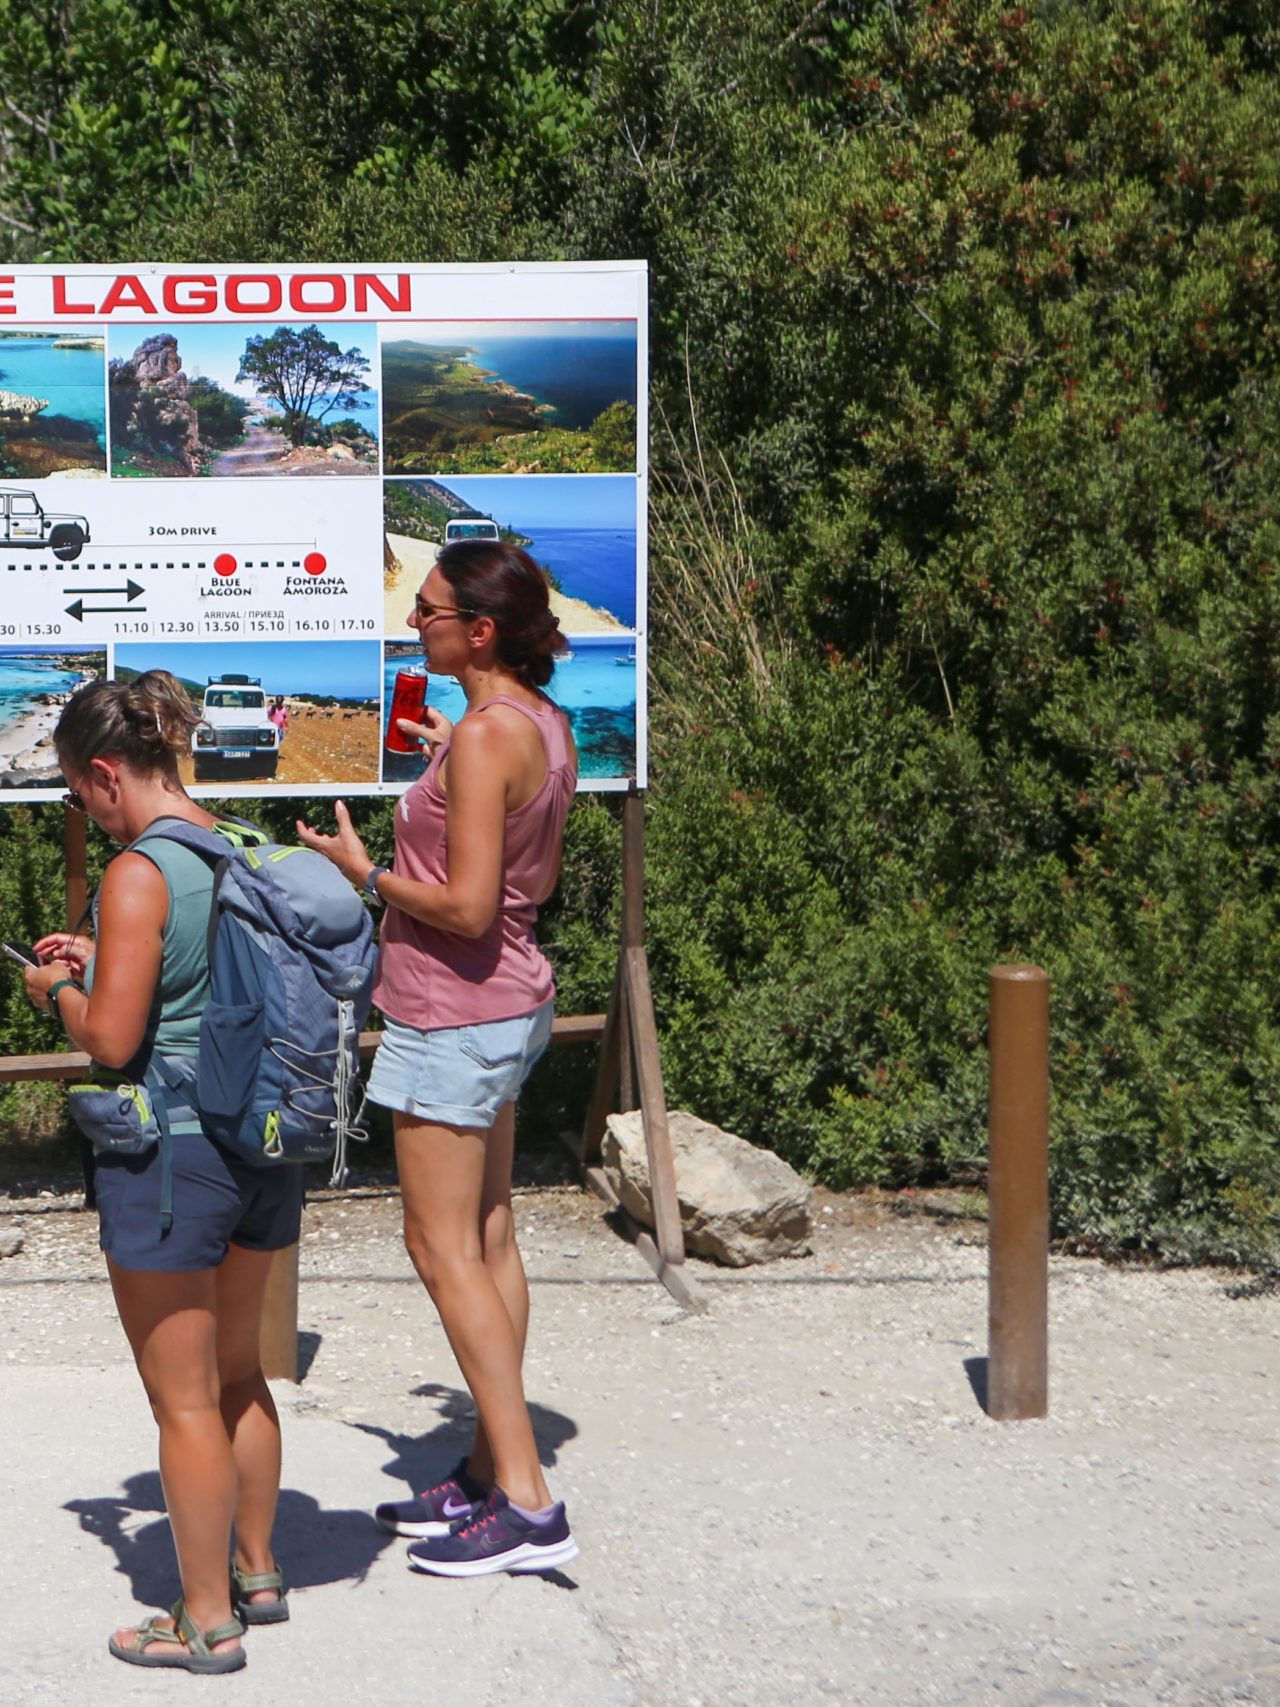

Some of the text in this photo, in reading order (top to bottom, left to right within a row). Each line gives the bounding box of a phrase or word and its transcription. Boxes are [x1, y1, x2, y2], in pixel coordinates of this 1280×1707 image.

[53, 274, 412, 315] LAGOON
[148, 526, 218, 536] 30M DRIVE
[210, 577, 241, 587] BLUE
[286, 576, 346, 587] FONTANA
[200, 586, 252, 597] LAGOON
[283, 585, 349, 596] AMOROZA
[203, 611, 241, 619] ARRIVAL
[248, 610, 285, 620] ПРИЕЗД
[26, 623, 62, 635] 15.30
[114, 619, 375, 633] 11.10 12.30 13.50 15.10 16.10 17.10
